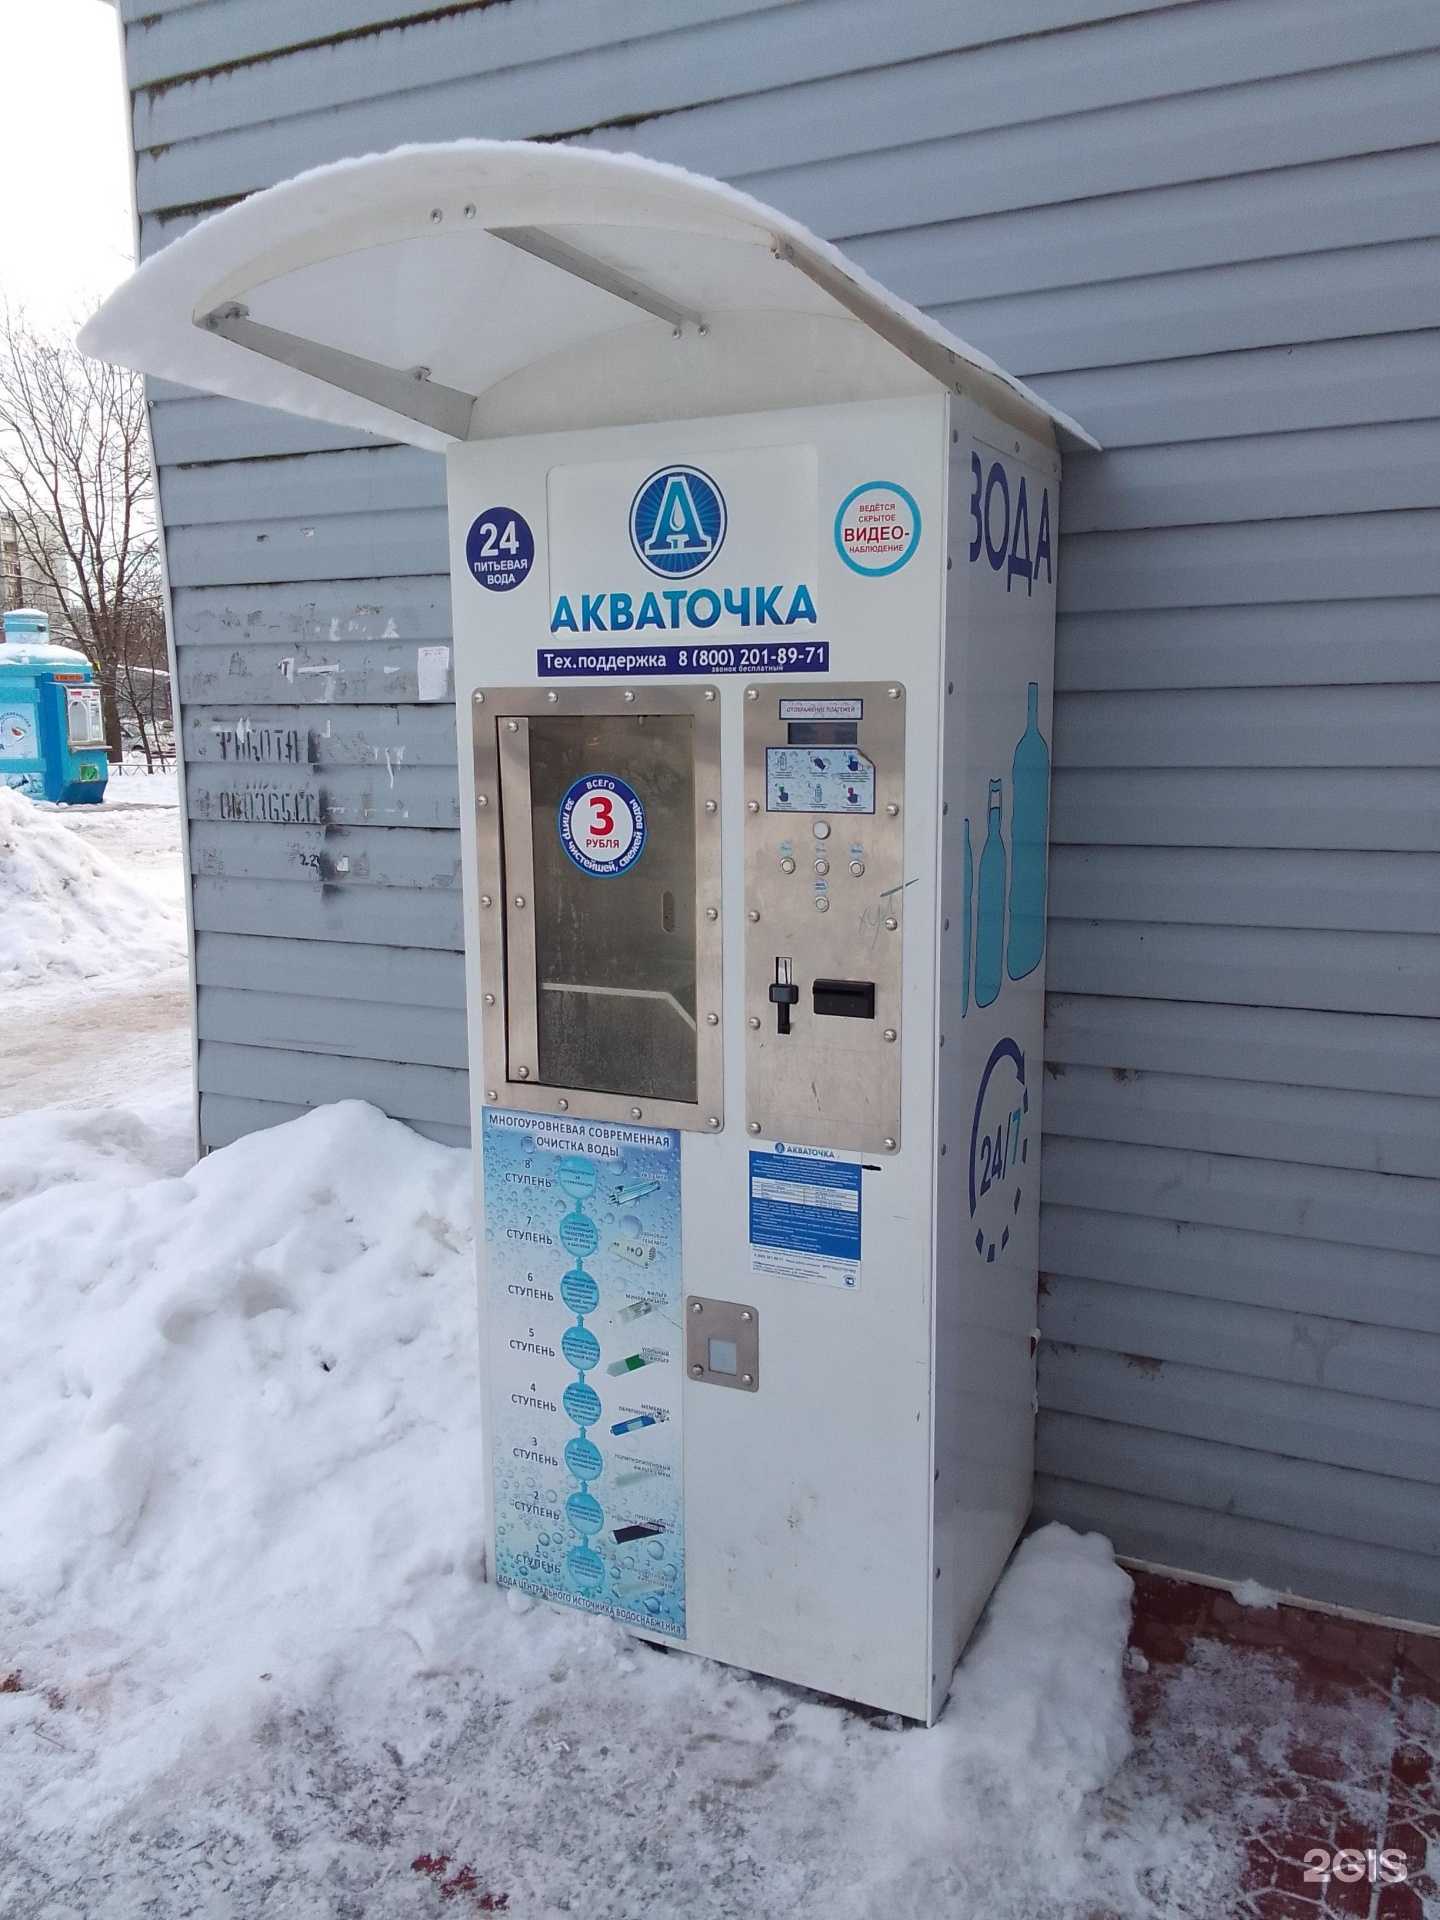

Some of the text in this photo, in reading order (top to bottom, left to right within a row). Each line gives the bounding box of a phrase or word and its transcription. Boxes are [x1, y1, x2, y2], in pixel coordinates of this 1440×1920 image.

[859, 502, 896, 513] ВЕДЁТСЯ
[858, 514, 897, 524] СКРЫТОЕ
[479, 520, 519, 557] 24
[843, 525, 910, 545] ВИДЕО-
[849, 544, 904, 554] НАБЛЮДЕНИЕ
[473, 558, 529, 573] ПИТЬЕВАЯ
[486, 573, 517, 586] ВОДА
[550, 583, 818, 634] АКВАТОЧКА
[543, 646, 825, 672] Тех.поддержка 8 (800) 201-89-71
[711, 664, 785, 674] звонок бесплатный
[586, 779, 616, 791] ВСЕГО
[564, 798, 575, 811] за
[589, 796, 615, 837] 3
[629, 799, 644, 830] воды
[561, 811, 571, 841] литр
[586, 838, 620, 849] РУБЛЯ
[619, 832, 644, 868] свежей
[489, 1113, 670, 1148] МНОГОУРОВНЕВАЯ СОВРЕМЕННАЯ
[536, 1136, 620, 1158] ОЧИСТКА ВОДЫ
[786, 1145, 835, 1159] АКВАТОЧКА
[524, 1159, 531, 1169] 8
[505, 1173, 552, 1188] СТУПЕНЬ
[526, 1216, 532, 1225] 7
[506, 1229, 553, 1245] СТУПЕНЬ
[527, 1272, 534, 1282] 6
[508, 1284, 554, 1301] СТУПЕНЬ
[528, 1328, 535, 1338] 5
[509, 1339, 556, 1357] СТУПЕНЬ
[530, 1383, 536, 1393] 4
[511, 1394, 557, 1413] СТУПЕНЬ
[531, 1437, 538, 1447] 3
[512, 1447, 559, 1467] СТУПЕНЬ
[533, 1490, 540, 1500] 2
[514, 1501, 561, 1521] СТУПЕНЬ
[515, 1554, 561, 1574] СТУПЕНЬ
[518, 1579, 572, 1602] ЦЕНТРАЛЬНОГО
[572, 1595, 615, 1615] ИСТОЧНИКА
